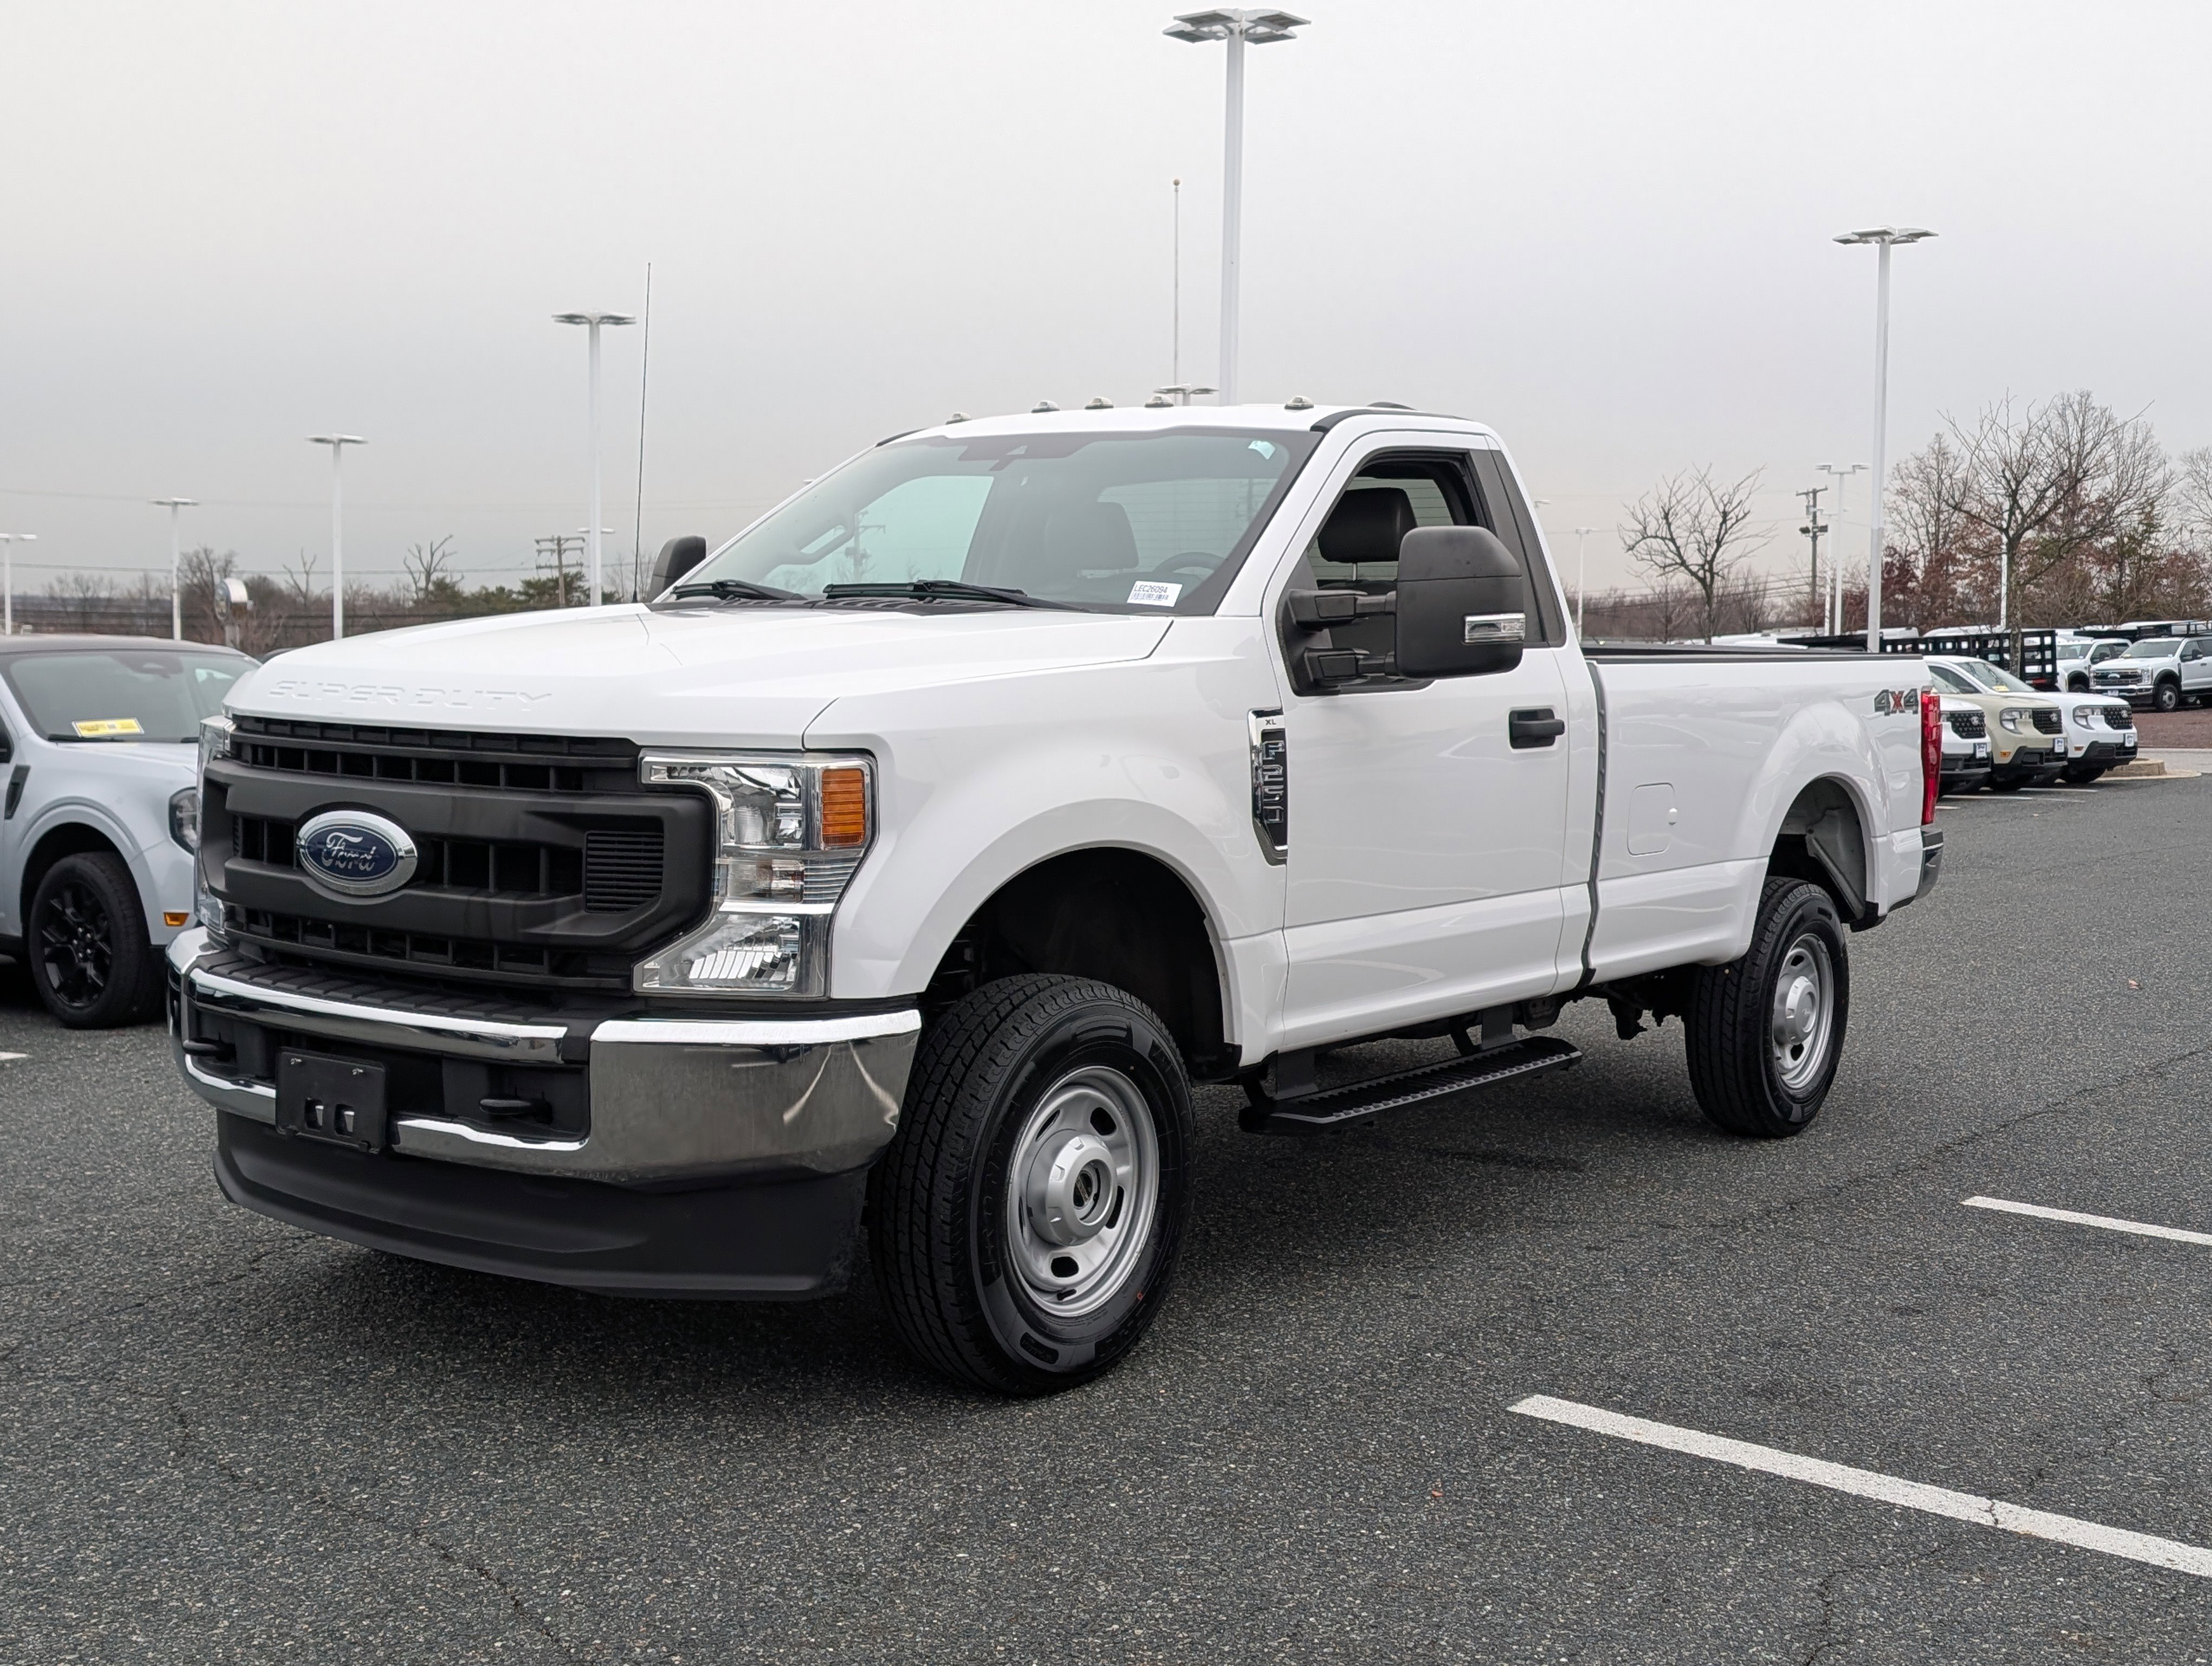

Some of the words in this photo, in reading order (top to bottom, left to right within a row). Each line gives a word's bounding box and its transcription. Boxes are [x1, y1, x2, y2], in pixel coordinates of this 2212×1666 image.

[1134, 584, 1168, 593] LEC26094
[268, 680, 406, 706] SUPER
[408, 688, 552, 712] DUTY
[321, 831, 377, 872] Ford
